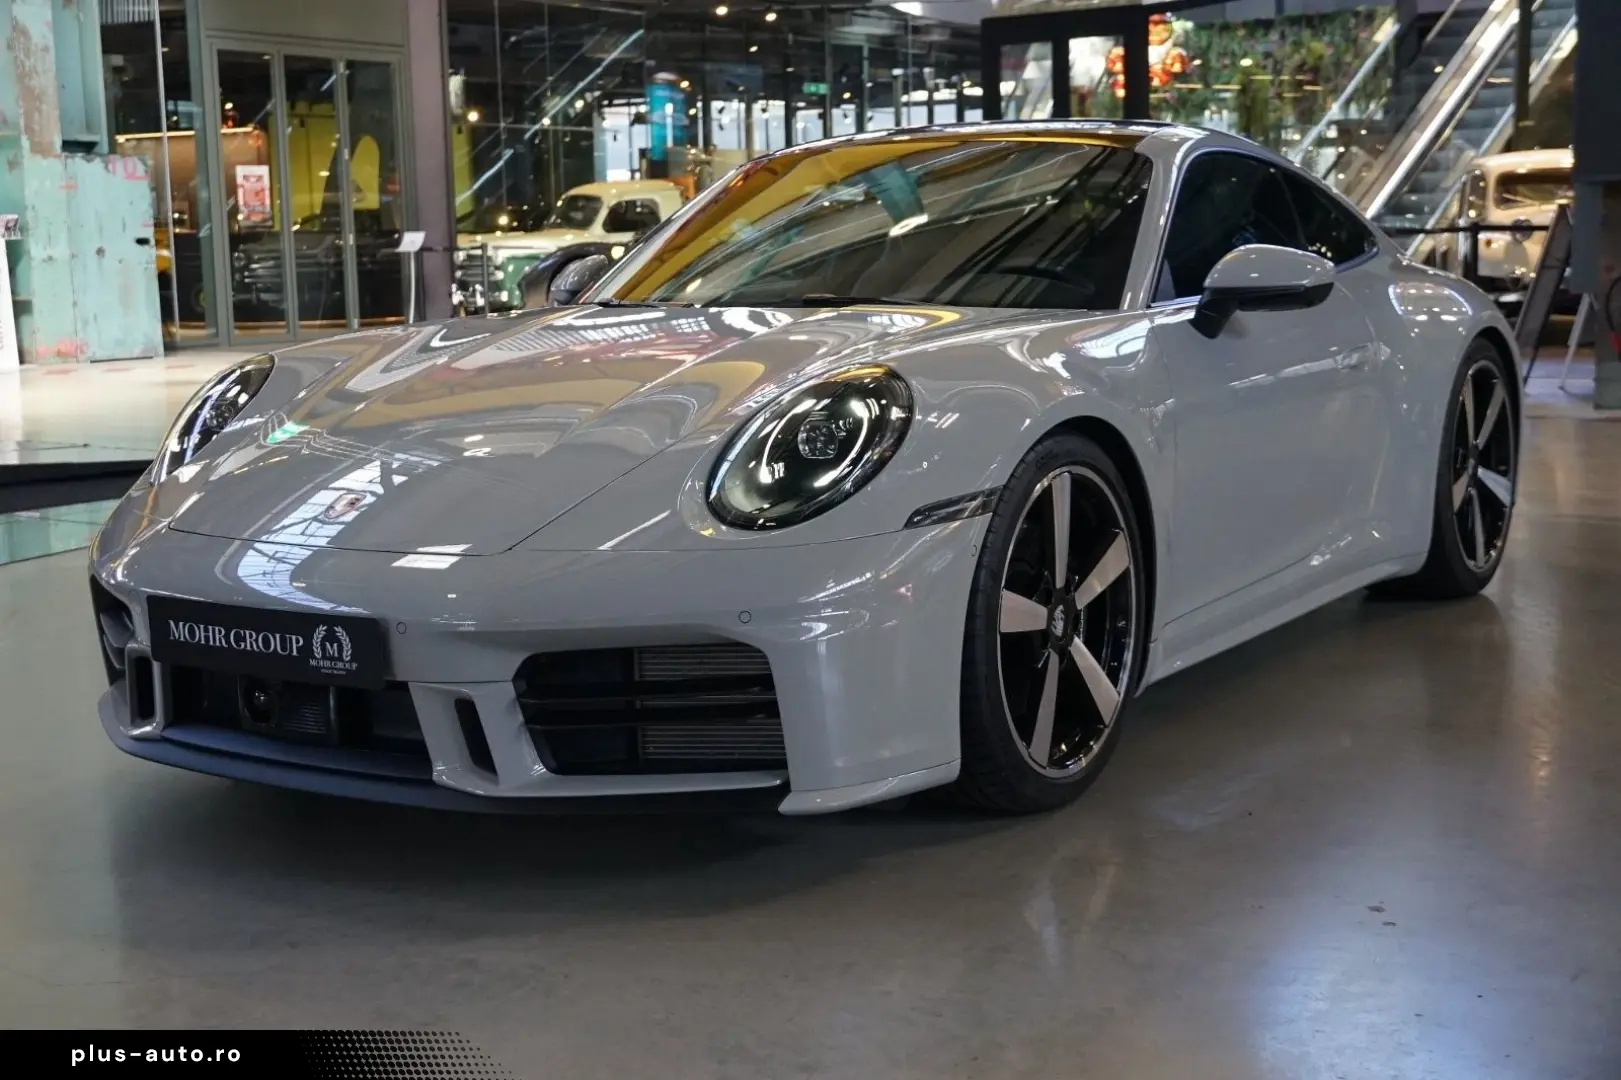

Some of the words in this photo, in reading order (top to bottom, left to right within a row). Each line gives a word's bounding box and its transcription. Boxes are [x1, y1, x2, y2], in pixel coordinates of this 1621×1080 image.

[168, 620, 228, 647] MOHR
[230, 628, 304, 656] GROUP
[325, 641, 339, 657] M
[309, 658, 331, 668] MOHR
[331, 661, 358, 671] GROUP
